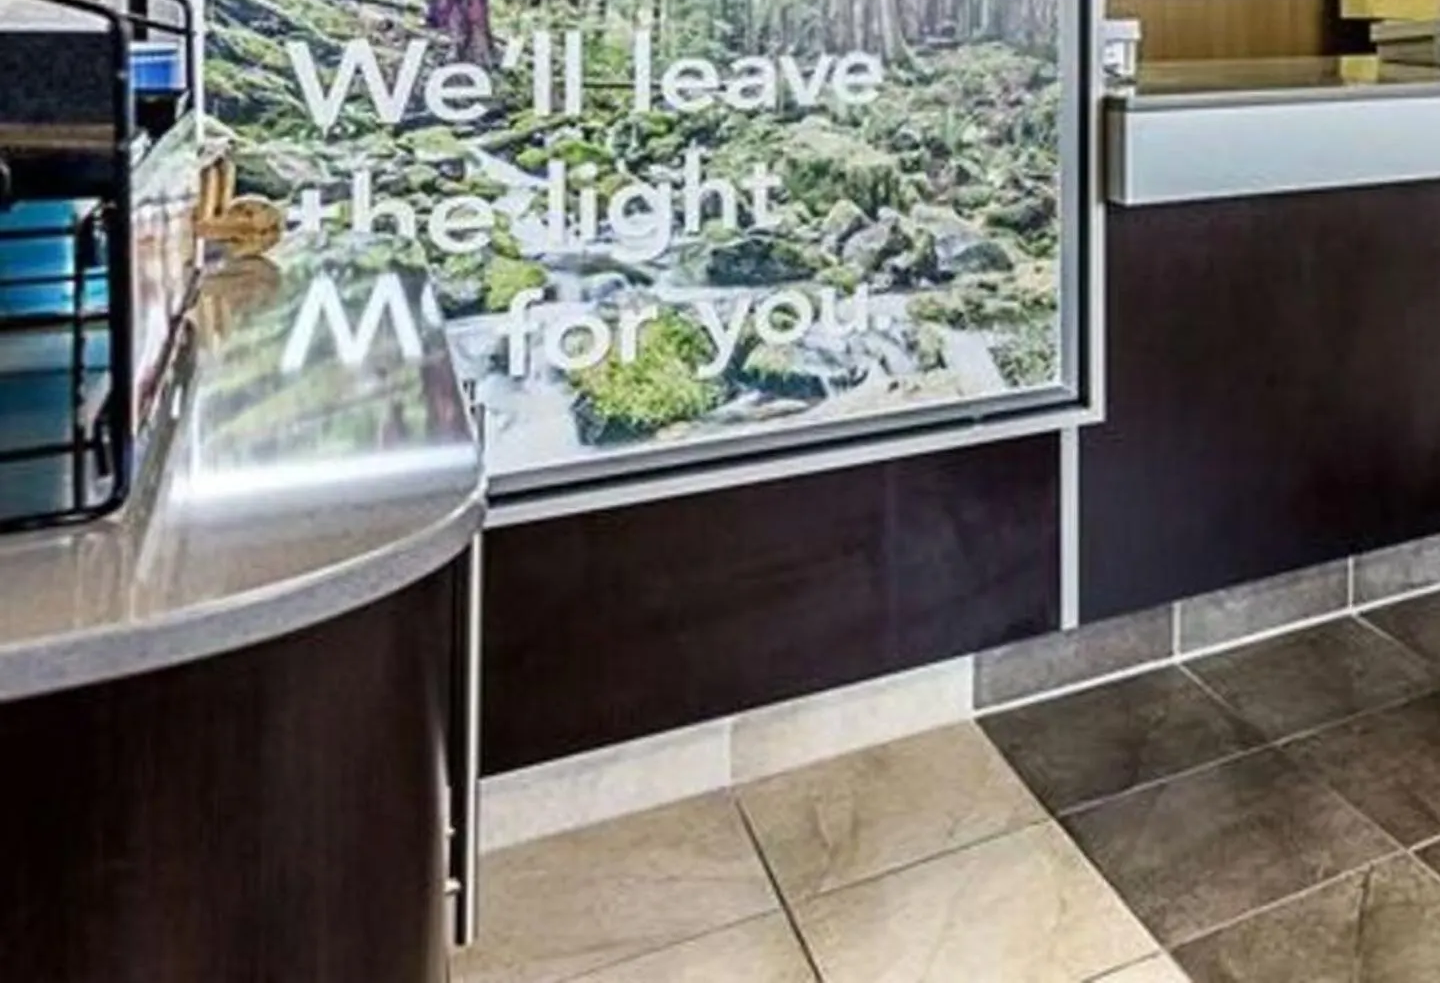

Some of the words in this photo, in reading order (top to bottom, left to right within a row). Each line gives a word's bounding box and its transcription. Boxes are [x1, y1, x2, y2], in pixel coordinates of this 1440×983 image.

[286, 30, 583, 137] We'll
[633, 29, 884, 114] leave
[286, 169, 495, 254] the
[547, 140, 782, 264] light
[499, 287, 660, 377] for
